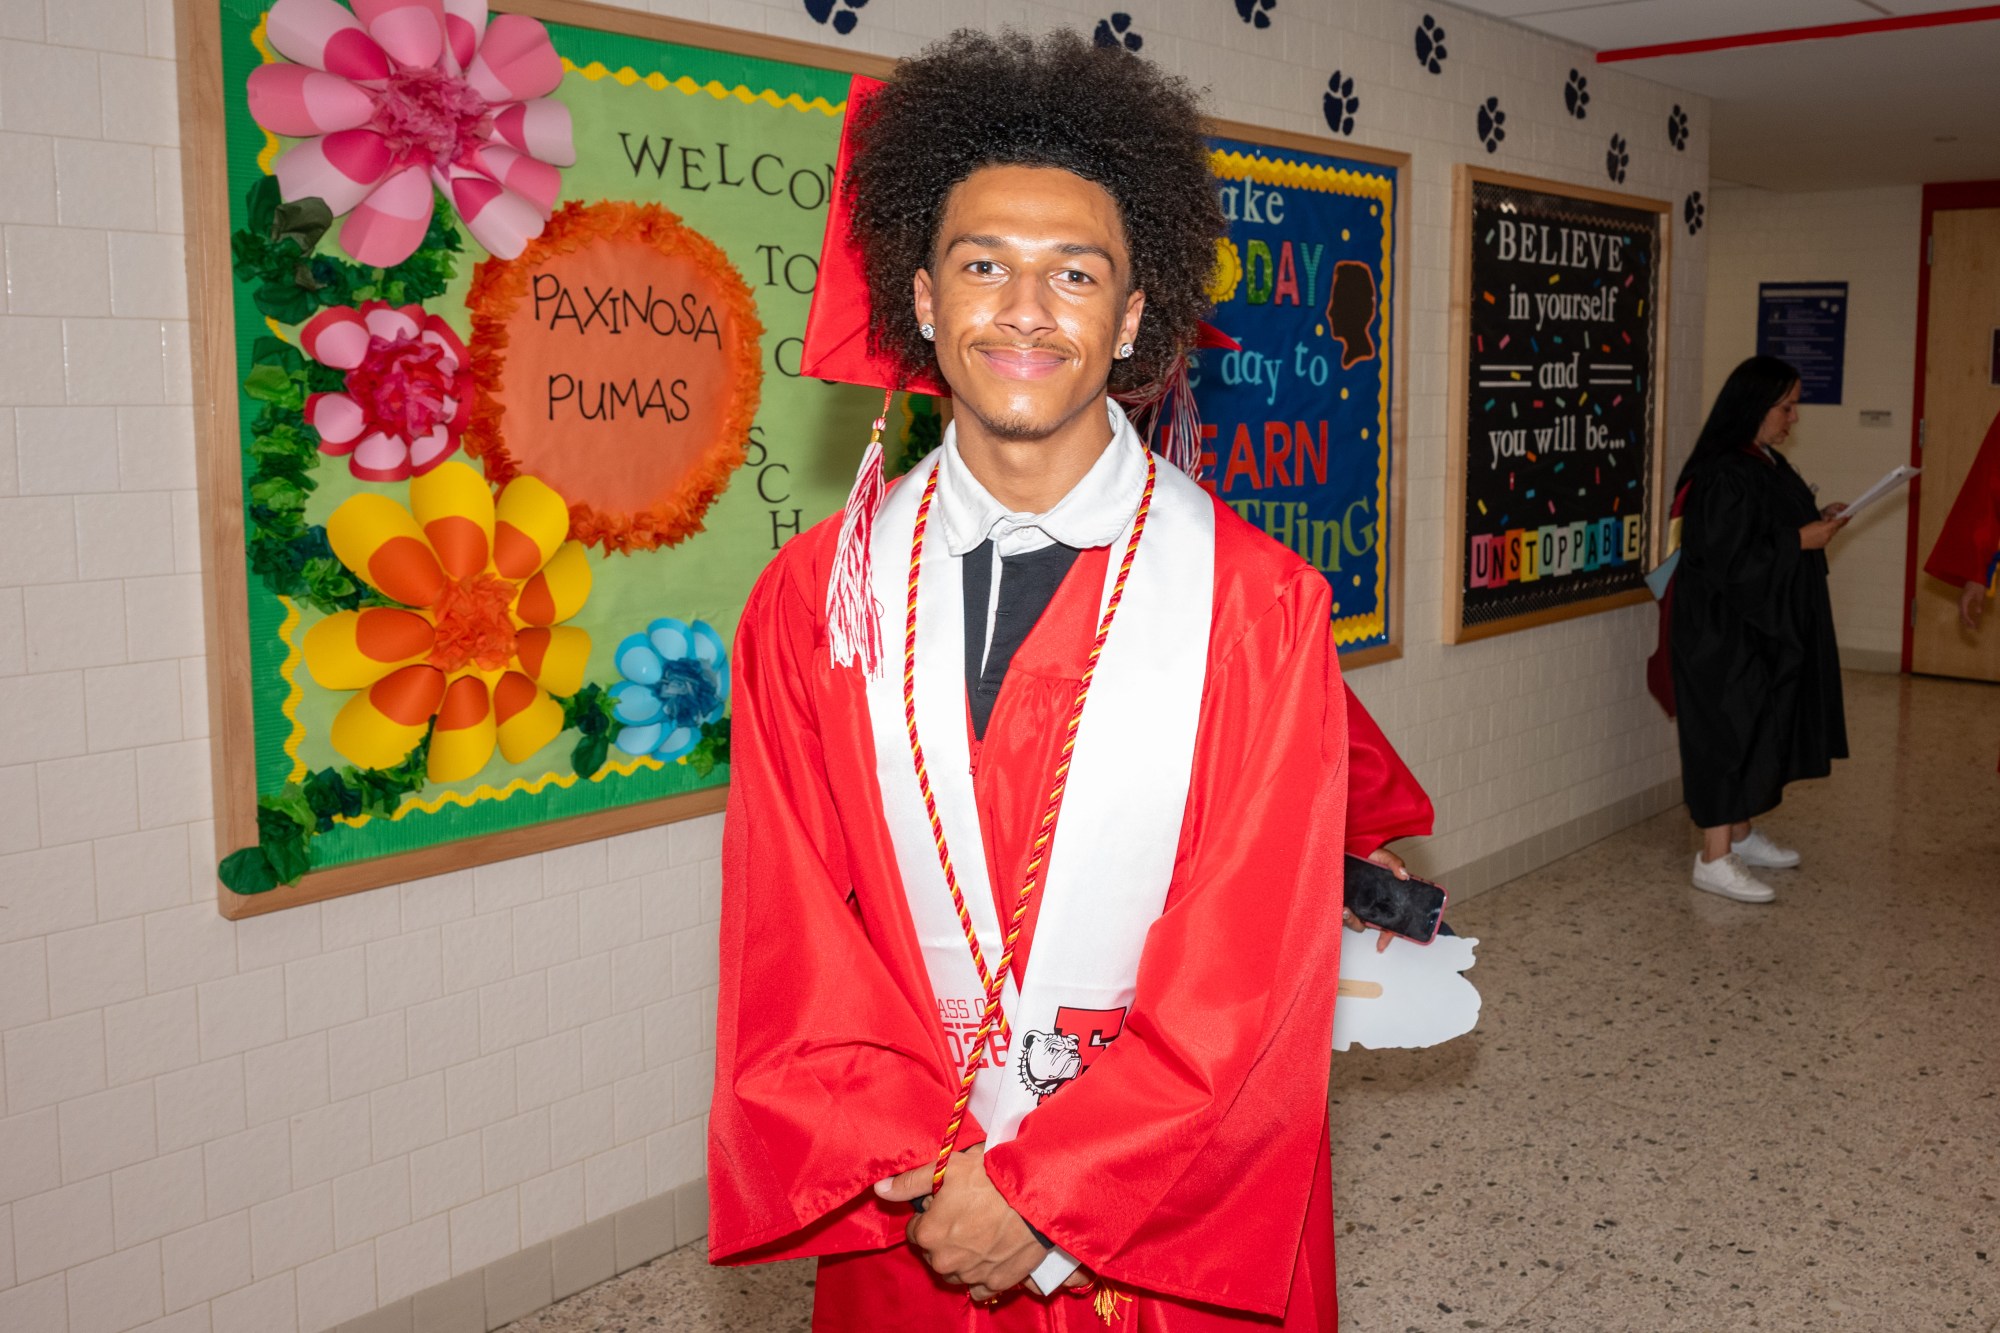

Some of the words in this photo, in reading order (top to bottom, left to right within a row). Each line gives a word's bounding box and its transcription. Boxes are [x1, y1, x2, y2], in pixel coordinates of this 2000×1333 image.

[617, 131, 836, 211] WELCO
[1219, 175, 1285, 225] ake
[755, 244, 819, 294] TO
[1497, 219, 1624, 273] BELIEVE
[533, 273, 722, 350] PAXINOSA
[1508, 283, 1530, 320] in
[1534, 285, 1619, 332] yourself
[1221, 337, 1283, 406] day
[1294, 342, 1329, 386] to
[1538, 351, 1580, 390] and
[548, 373, 690, 424] PUMAS
[1488, 429, 1527, 471] you
[1533, 415, 1577, 454] will
[1585, 414, 1626, 451] be...
[1475, 521, 1638, 581] UNSTOPPABLE
